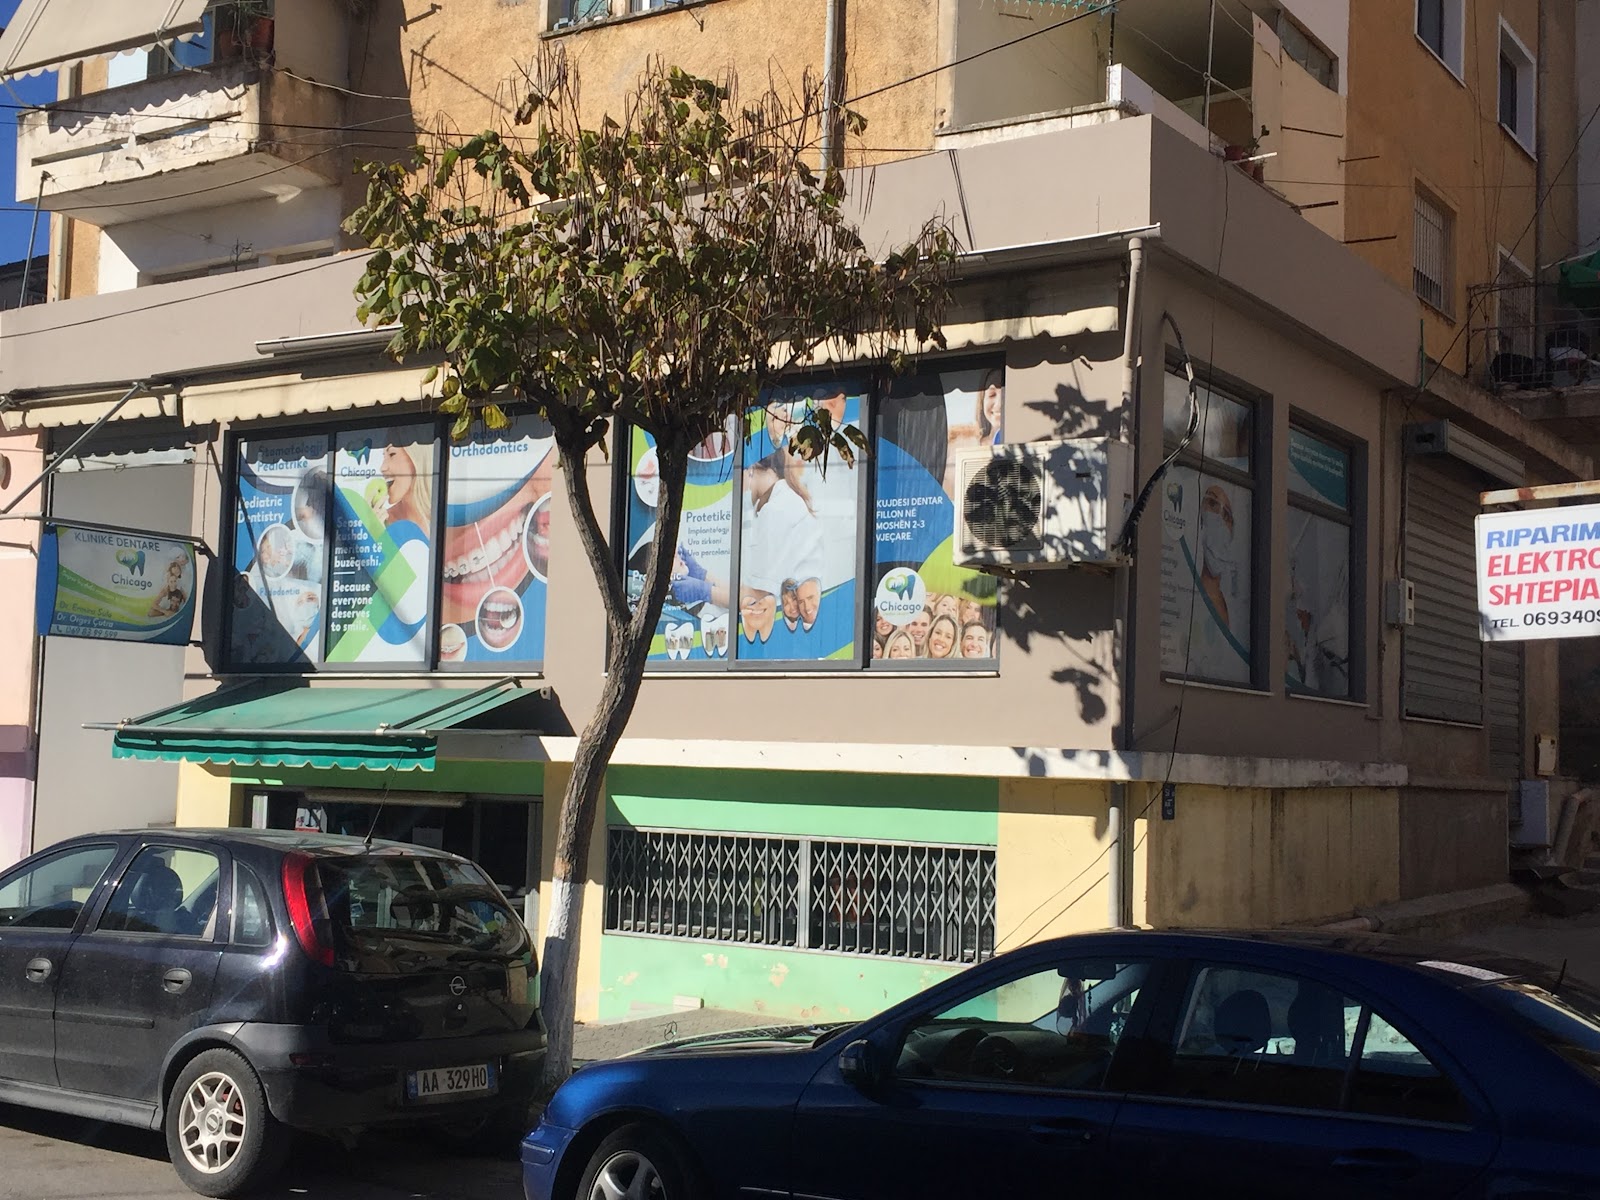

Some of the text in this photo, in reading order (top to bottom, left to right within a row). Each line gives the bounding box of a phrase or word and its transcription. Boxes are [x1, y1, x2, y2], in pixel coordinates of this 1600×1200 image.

[451, 443, 528, 457] Orthodontics
[340, 466, 376, 479] Chicago
[876, 496, 943, 508] KUJDESI DENTAR
[686, 510, 731, 523] Protetikë
[876, 507, 917, 519] FILLON NË
[876, 520, 925, 530] MOSHËN 2-3
[1486, 522, 1600, 549] RIPARIM
[116, 538, 160, 552] DENTARE
[372, 542, 383, 553] të
[1487, 547, 1600, 577] ELEKTRO
[111, 573, 153, 591] Chicago
[333, 580, 371, 592] Because
[332, 597, 373, 609] everyone
[879, 600, 922, 614] Chicago
[331, 607, 370, 619] deserves
[331, 622, 341, 631] to
[1491, 619, 1519, 629] TEL.
[423, 1072, 439, 1093] AA
